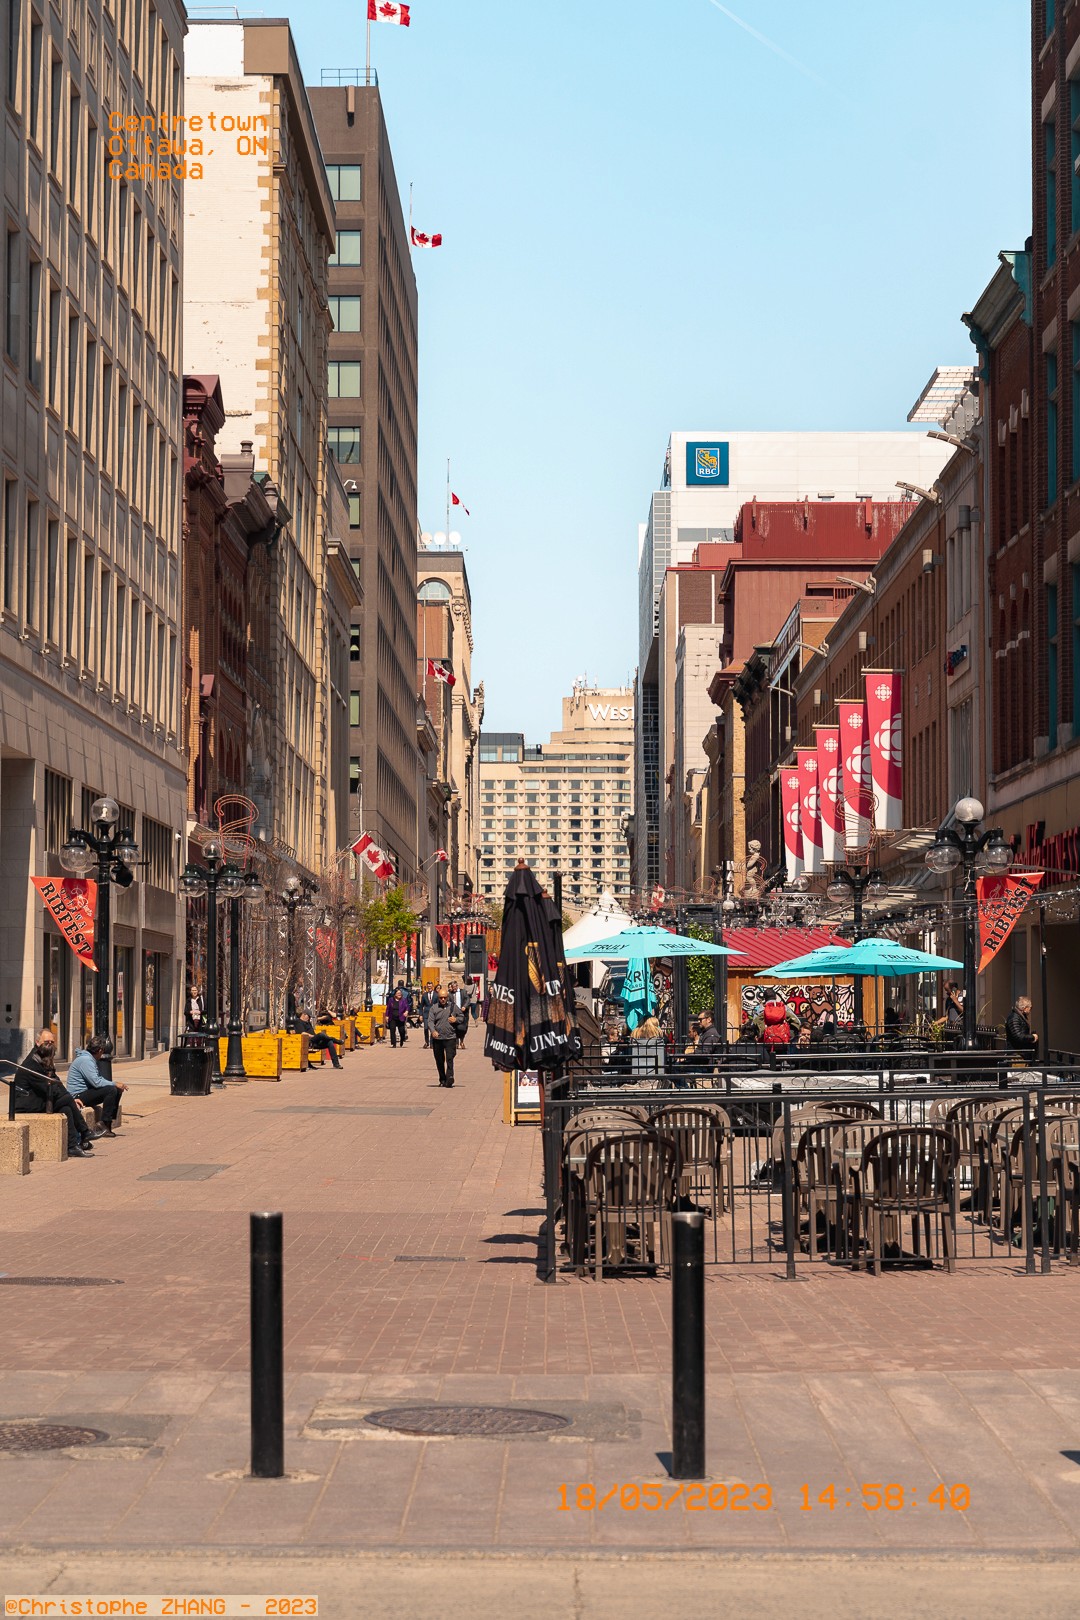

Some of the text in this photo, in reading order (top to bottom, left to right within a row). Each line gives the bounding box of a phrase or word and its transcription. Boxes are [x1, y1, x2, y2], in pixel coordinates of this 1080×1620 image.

[40, 881, 93, 955] RIBFEST
[60, 887, 87, 929] OTTAWA
[983, 877, 1035, 953] RIBFEST
[878, 953, 920, 961] TRULY
